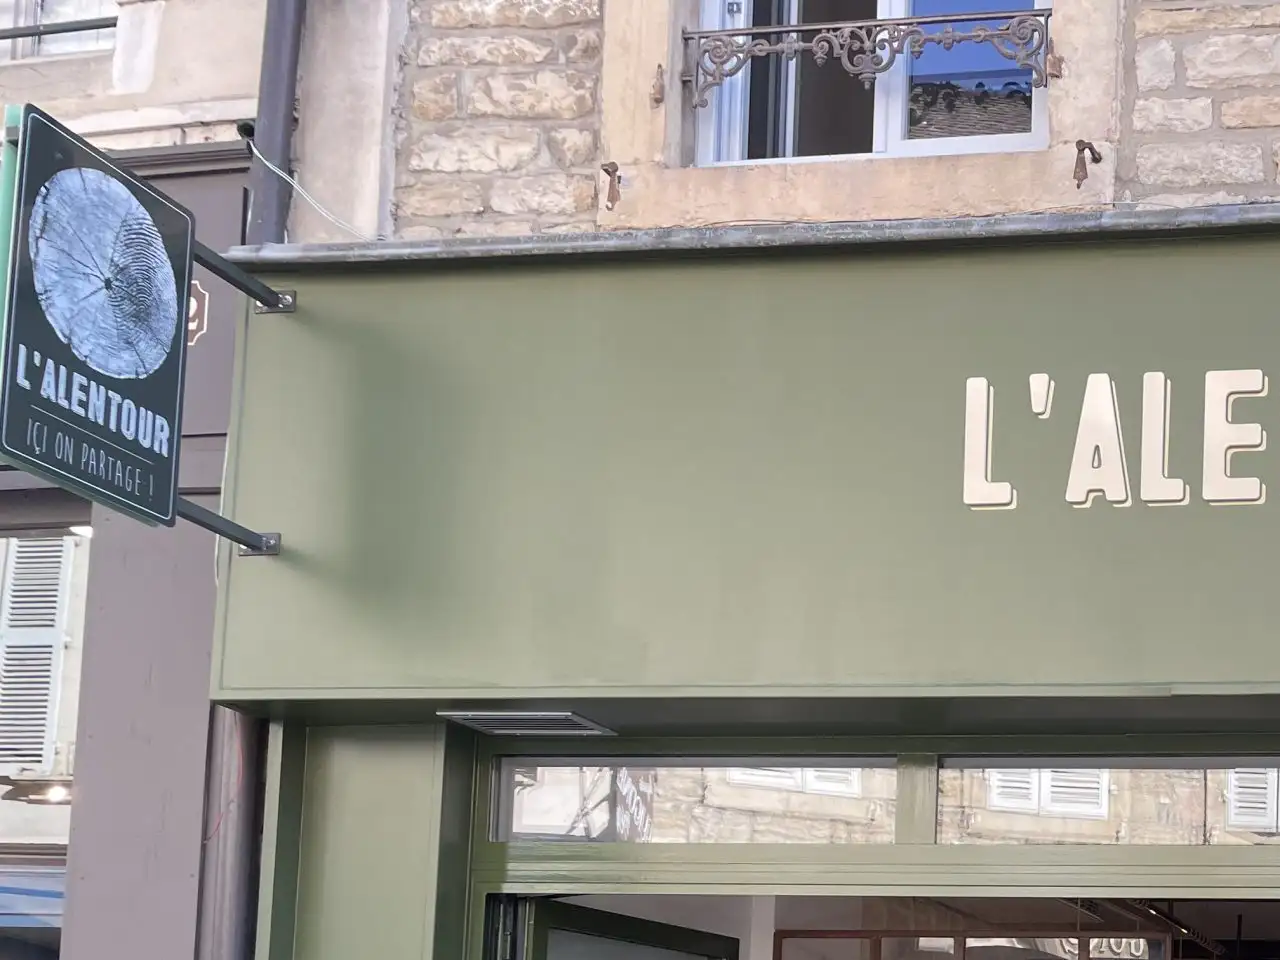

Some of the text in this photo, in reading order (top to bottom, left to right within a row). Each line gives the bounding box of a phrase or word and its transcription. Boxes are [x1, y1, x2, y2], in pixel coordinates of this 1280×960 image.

[16, 343, 170, 458] L'ALENTOUR
[54, 431, 74, 465] ON
[81, 442, 142, 496] PARTAGE
